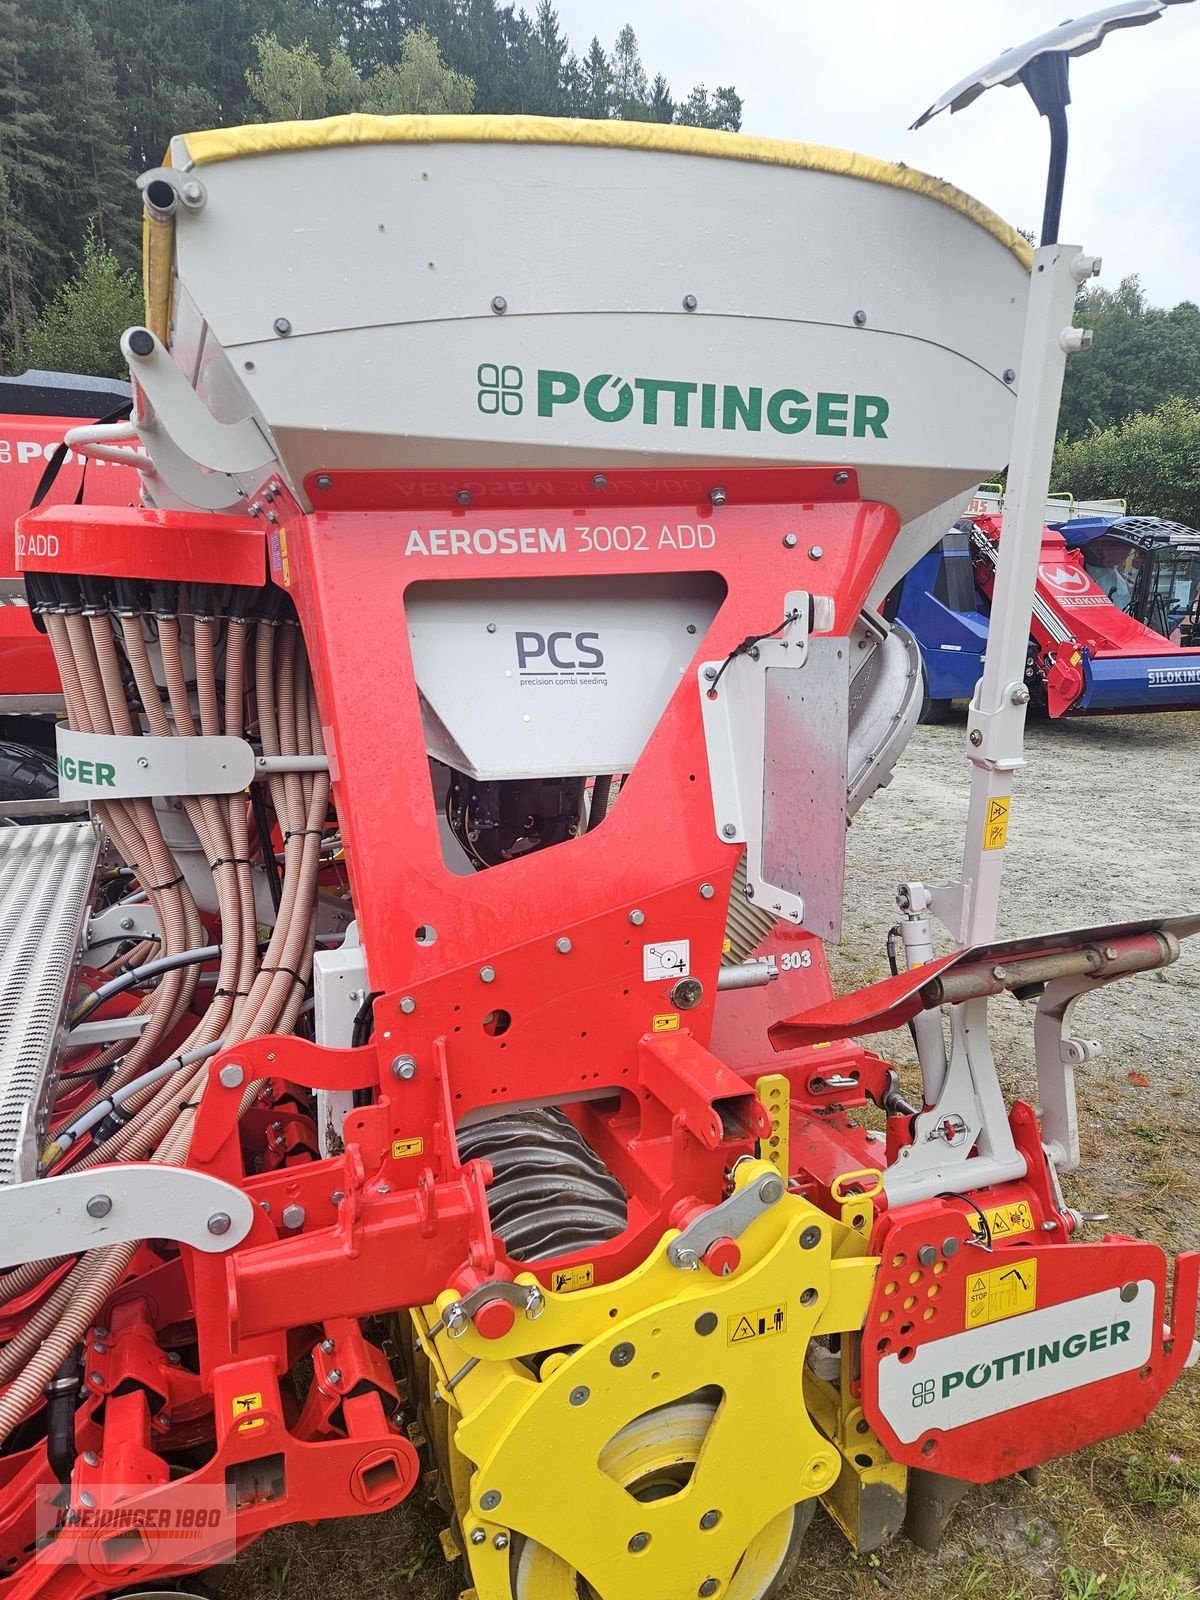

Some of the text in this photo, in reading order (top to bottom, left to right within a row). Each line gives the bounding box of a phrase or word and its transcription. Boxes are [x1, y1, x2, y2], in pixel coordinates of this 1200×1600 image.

[537, 369, 889, 438] PÖTTINGER
[28, 535, 59, 556] ADD
[404, 524, 716, 556] AEROSEM 3002 ADD
[515, 632, 604, 669] PCS
[520, 677, 608, 687] precision combi seeding
[781, 949, 812, 971] 303
[971, 1291, 988, 1303] STOP
[942, 1320, 1131, 1399] PÖTTINGER
